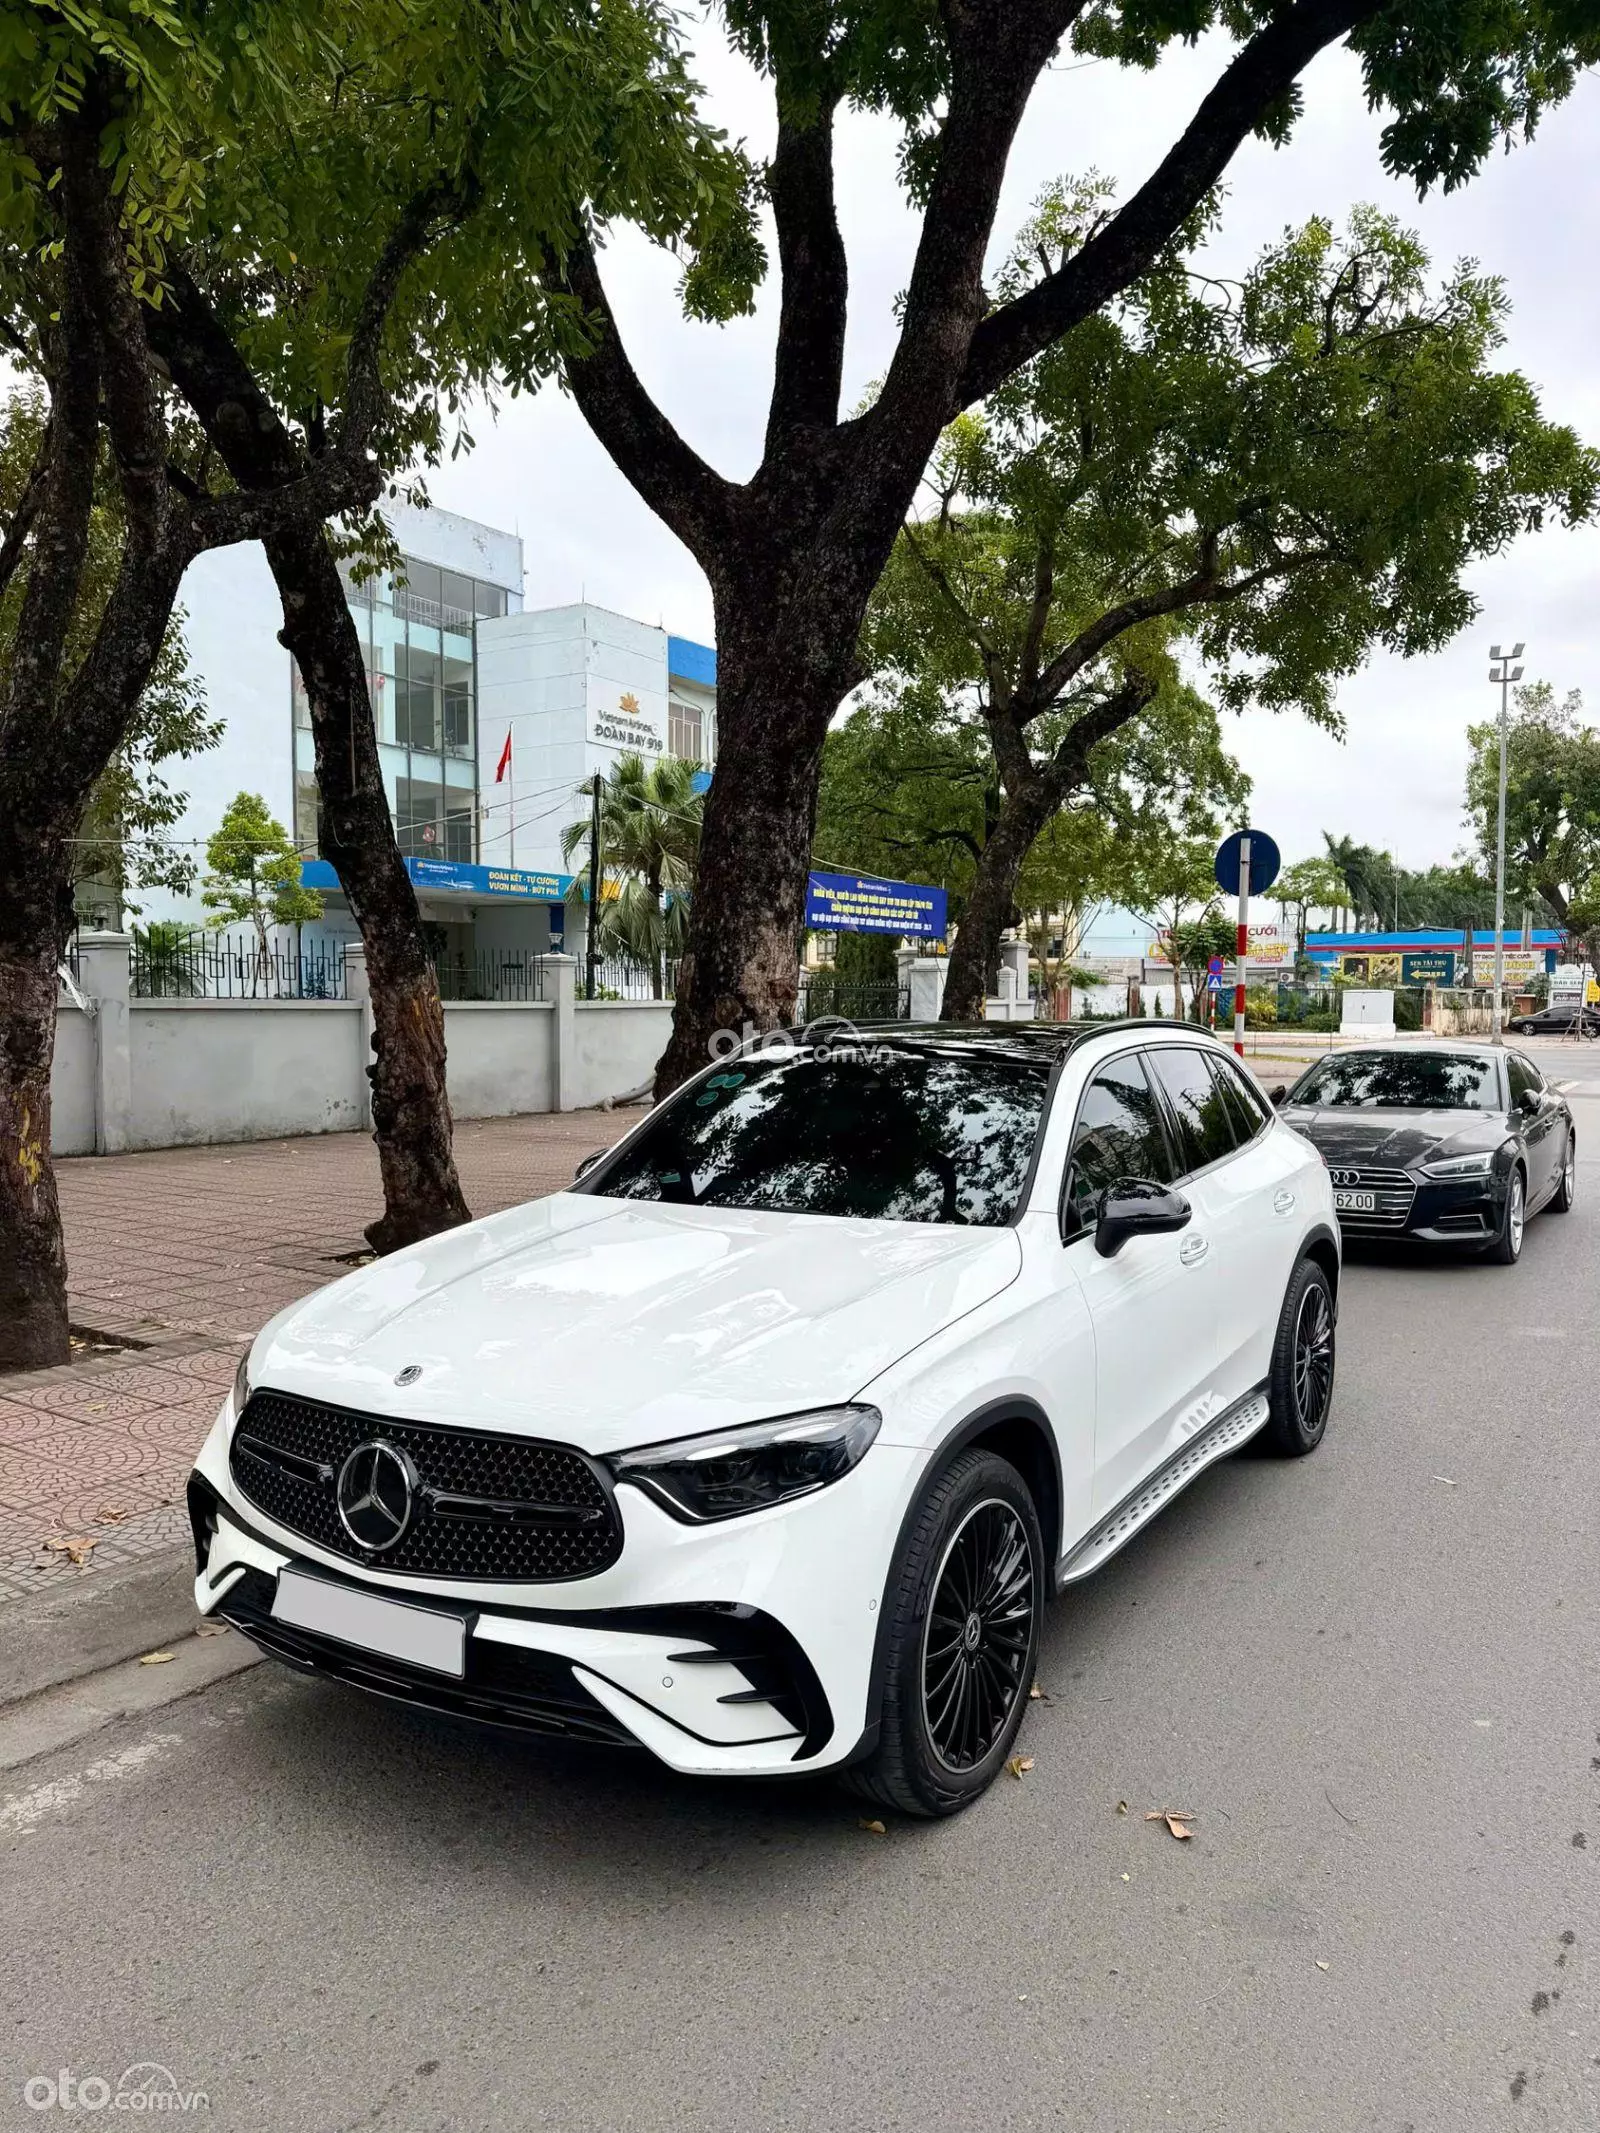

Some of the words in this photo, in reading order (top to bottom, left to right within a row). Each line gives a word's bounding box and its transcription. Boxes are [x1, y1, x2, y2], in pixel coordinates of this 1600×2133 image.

[598, 709, 628, 727] Vietnam
[594, 723, 626, 743] ĐOÀN
[627, 732, 647, 747] BAY
[647, 737, 663, 752] 919
[489, 871, 509, 881] ĐOÀN
[510, 872, 522, 882] KẾT
[1248, 925, 1277, 936] CƯỚI
[1333, 1193, 1372, 1208] 62.00
